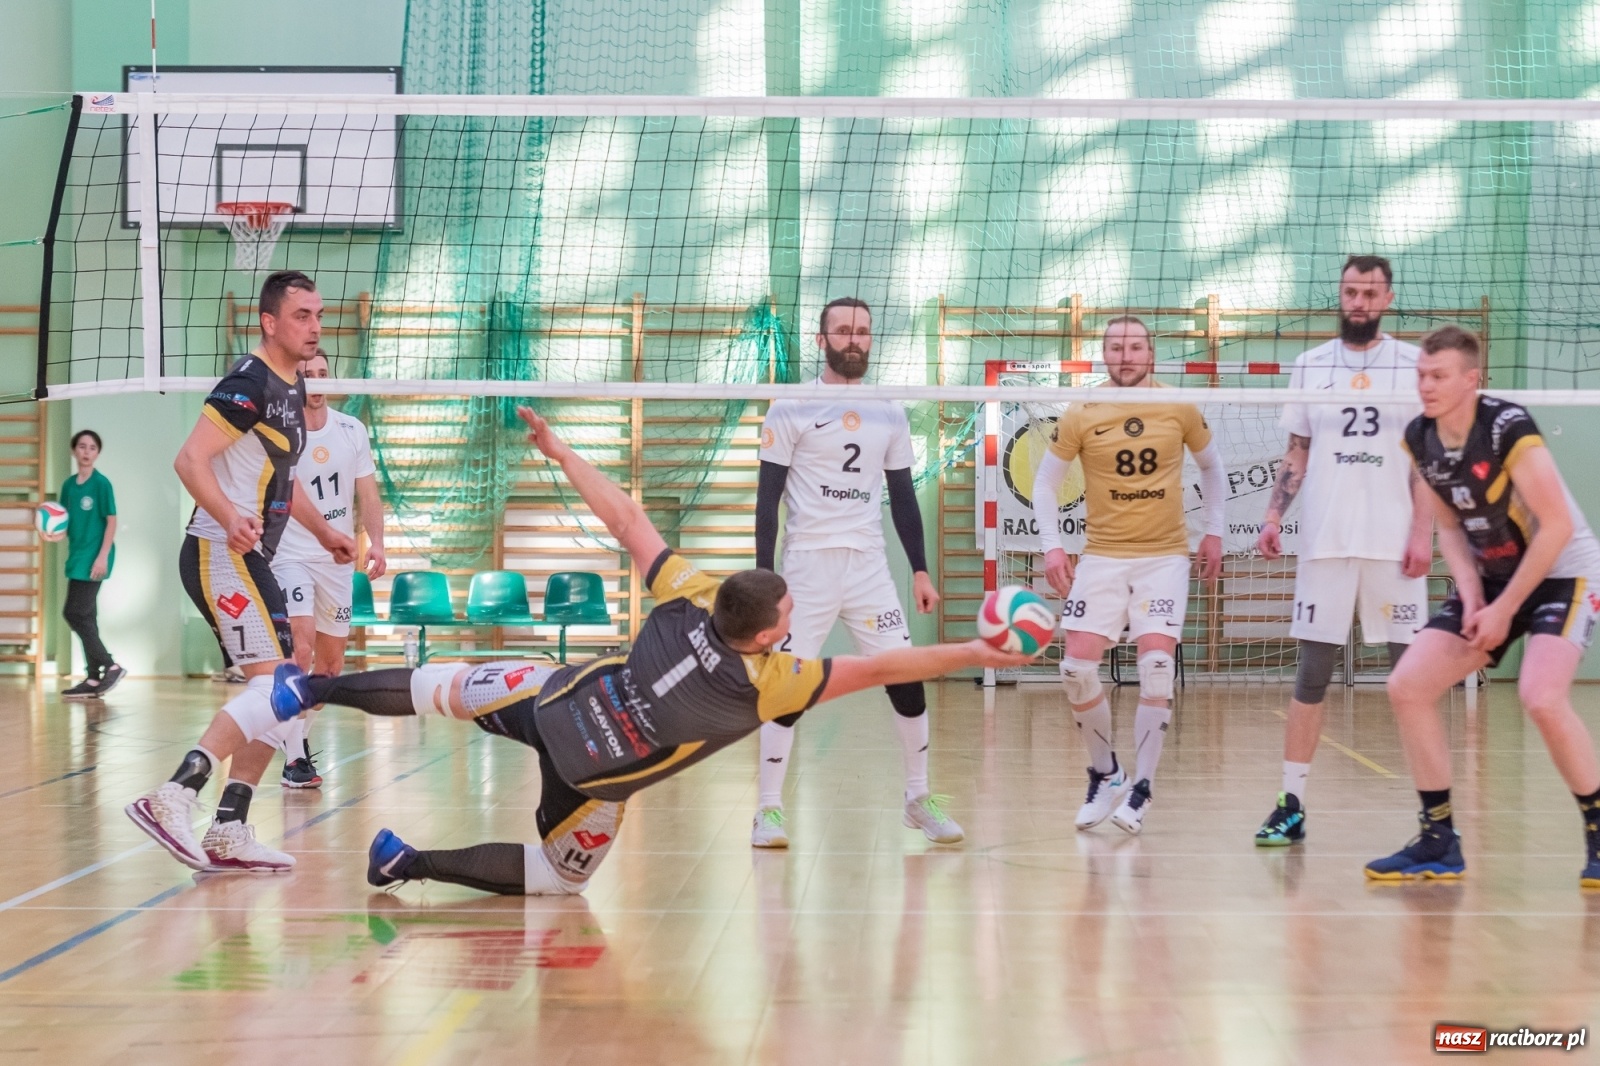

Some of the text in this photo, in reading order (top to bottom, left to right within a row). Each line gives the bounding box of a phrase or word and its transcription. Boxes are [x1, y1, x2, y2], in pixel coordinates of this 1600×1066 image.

[1341, 406, 1379, 437] 23
[842, 443, 861, 473] 2
[1115, 448, 1158, 477] 88
[1333, 452, 1384, 467] TropiDog
[310, 472, 339, 500] 11
[820, 485, 870, 503] TropiDog
[1109, 488, 1165, 502] TropiDog
[281, 587, 304, 603] 16
[1149, 599, 1175, 607] ZOO
[877, 609, 901, 622] ZOO
[1062, 600, 1086, 617] 88
[1297, 601, 1315, 623] 11
[1392, 604, 1418, 613] ZOO
[877, 617, 903, 631] MAR
[232, 625, 246, 651] 7
[780, 632, 792, 652] 2
[651, 654, 699, 698] 1
[563, 849, 593, 869] 14
